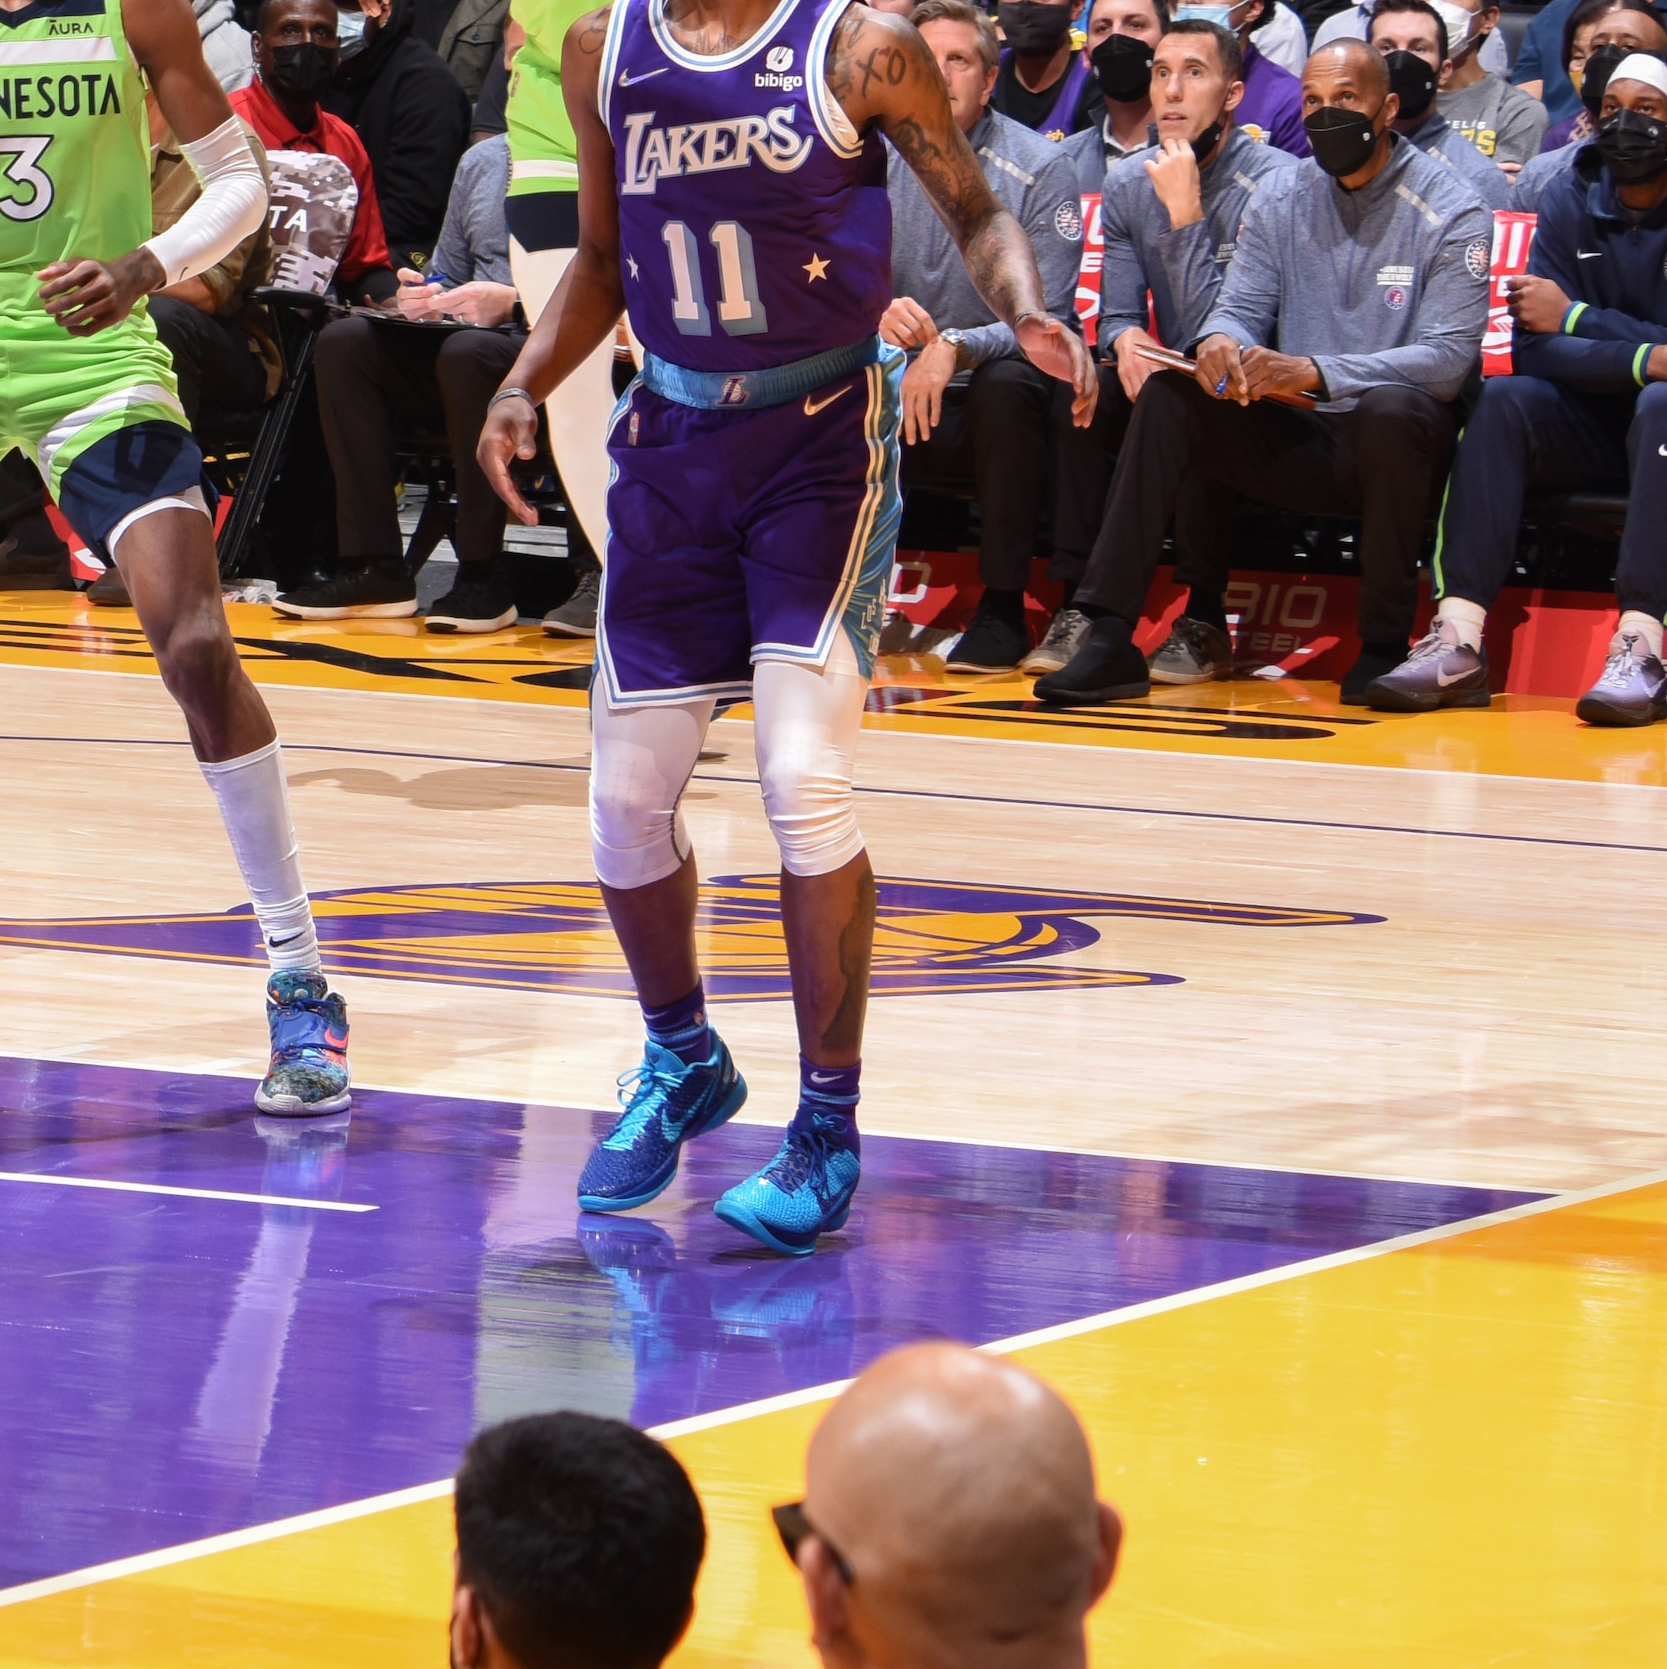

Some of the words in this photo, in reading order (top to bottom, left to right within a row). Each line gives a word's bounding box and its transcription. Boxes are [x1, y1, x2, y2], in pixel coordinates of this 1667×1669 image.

[755, 73, 802, 92] bibigo
[621, 105, 812, 195] LAKERS
[661, 220, 768, 338] 11
